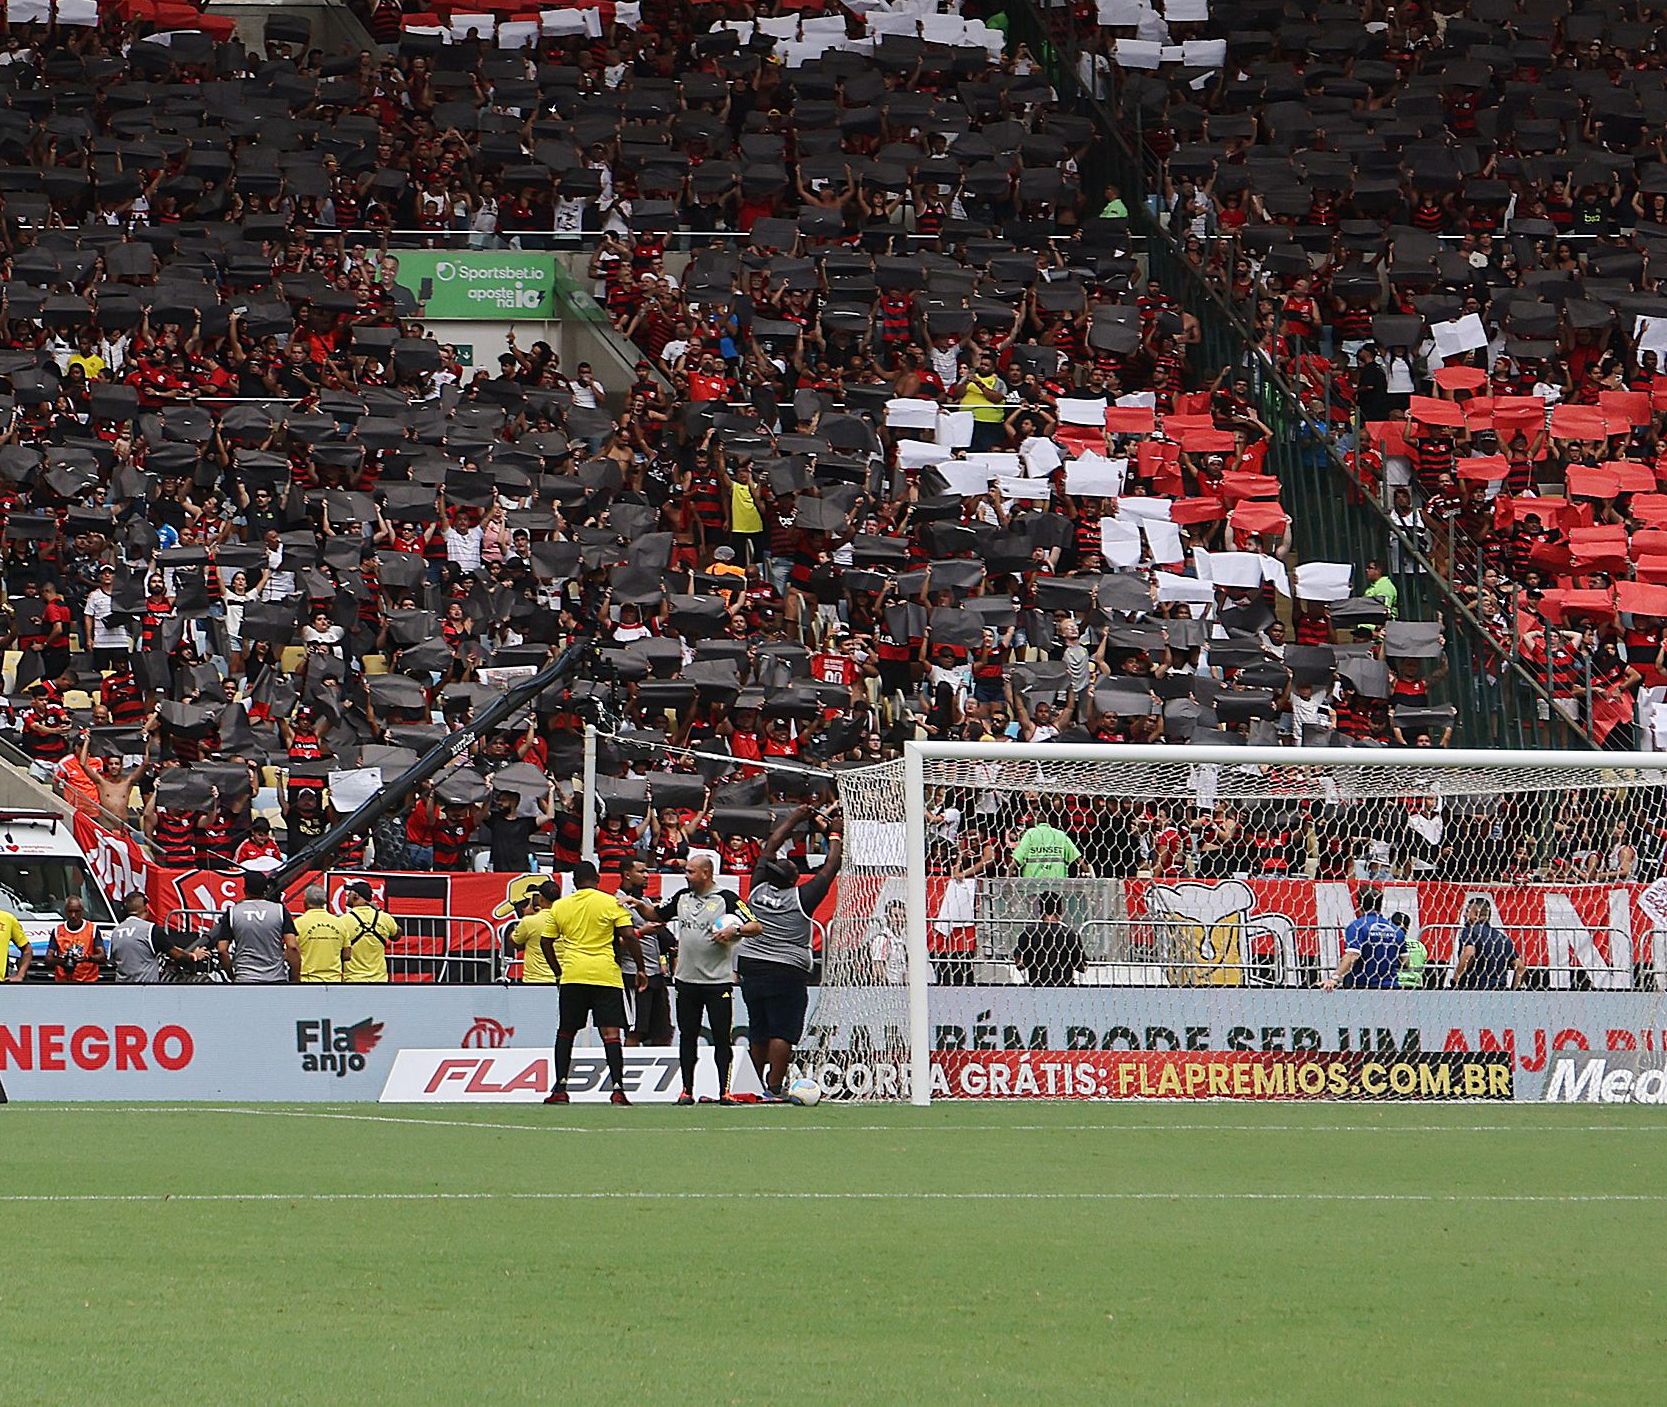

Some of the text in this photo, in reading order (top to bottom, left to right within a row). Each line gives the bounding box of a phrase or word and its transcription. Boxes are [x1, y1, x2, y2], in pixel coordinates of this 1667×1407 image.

[459, 265, 544, 281] Sportsbet.io
[467, 288, 514, 302] aposte
[497, 297, 515, 309] na
[242, 909, 267, 922] TV
[117, 925, 137, 939] TV
[296, 1017, 355, 1054] Fla
[301, 1050, 367, 1079] anjo
[958, 1051, 1107, 1097] GRÁTIS:
[1117, 1062, 1512, 1097] FLAPREMIOS.COM.BR
